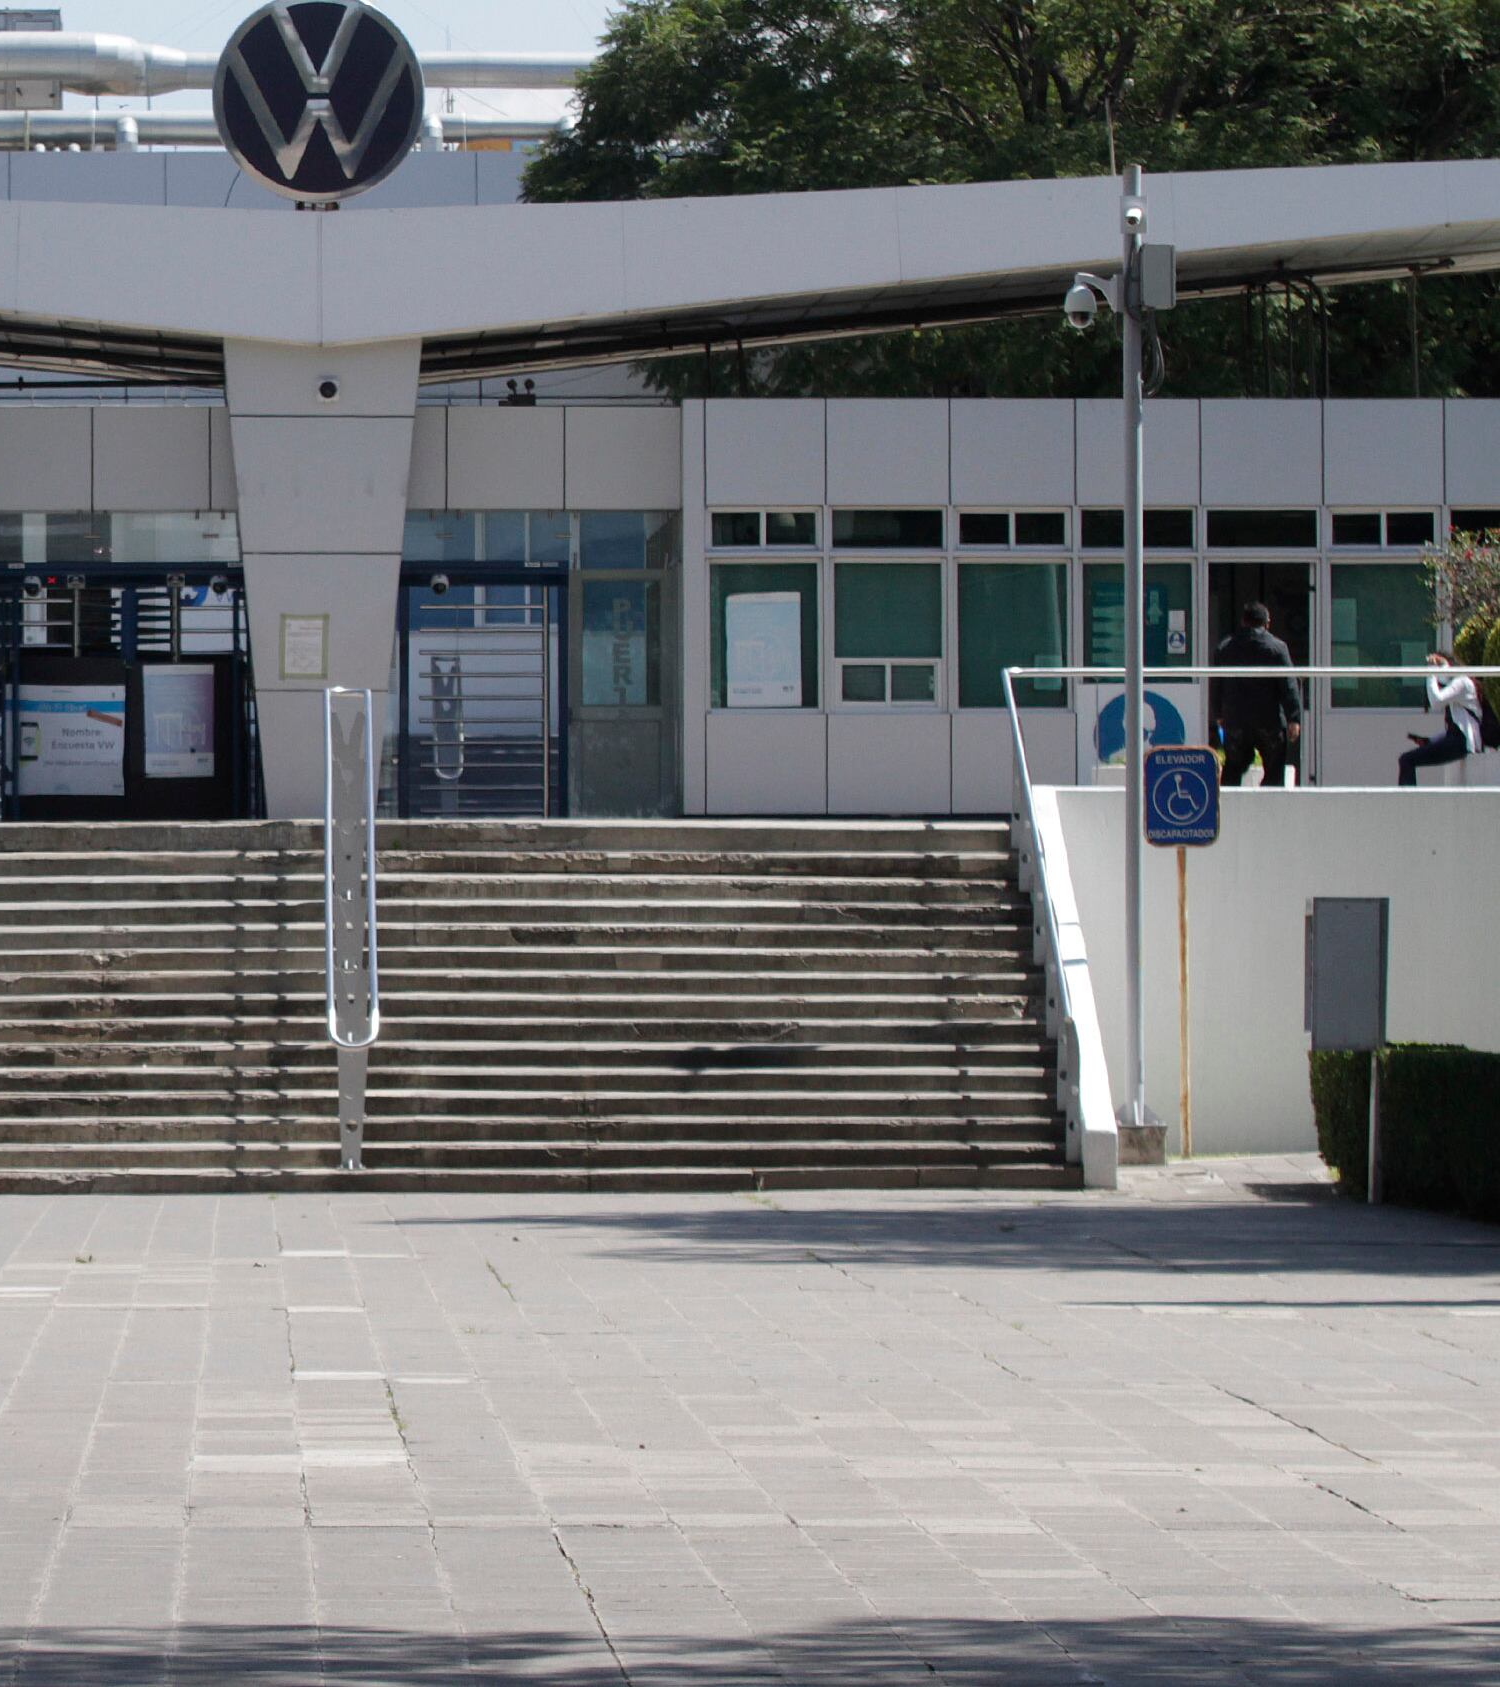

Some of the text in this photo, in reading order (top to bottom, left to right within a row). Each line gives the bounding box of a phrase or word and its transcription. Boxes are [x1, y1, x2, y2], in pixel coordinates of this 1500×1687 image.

[225, 2, 412, 182] VW
[51, 740, 116, 750] Encuesta VW
[1155, 755, 1206, 765] ELEVADOR
[1148, 829, 1214, 839] DISCAPACITADOS
